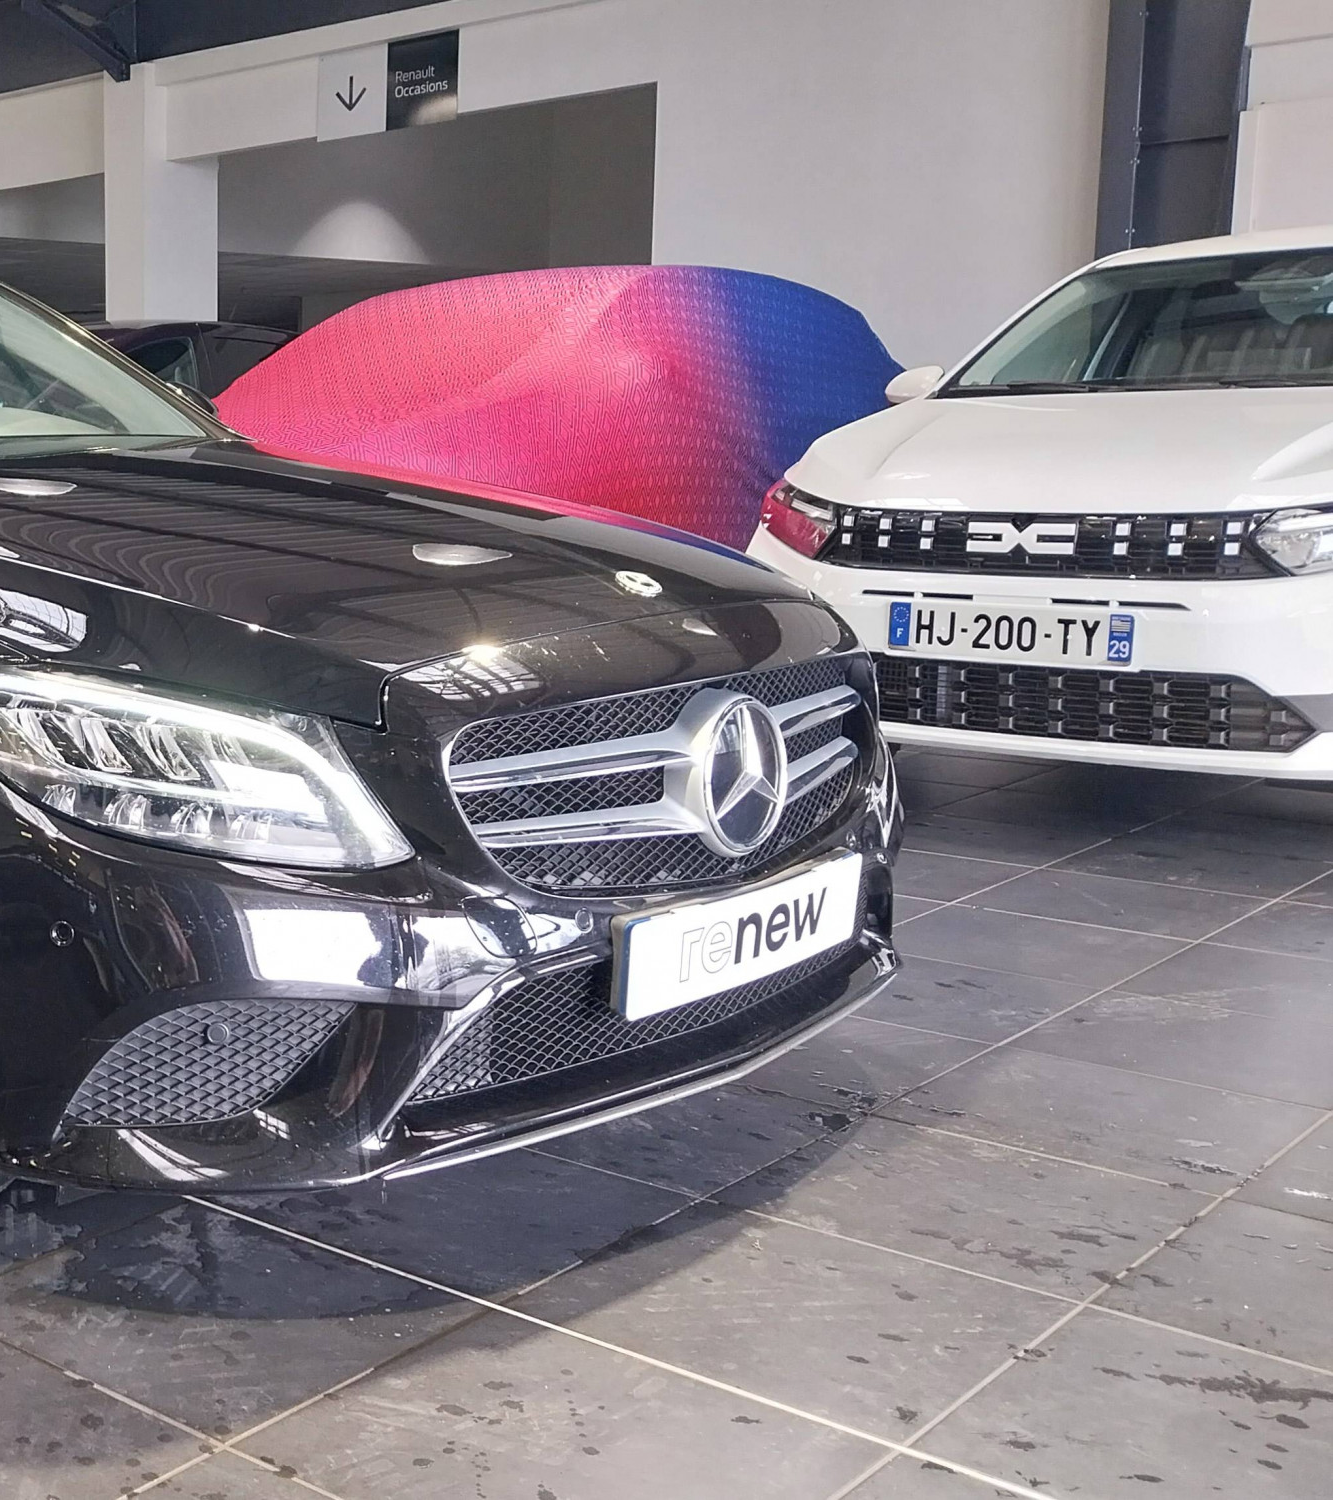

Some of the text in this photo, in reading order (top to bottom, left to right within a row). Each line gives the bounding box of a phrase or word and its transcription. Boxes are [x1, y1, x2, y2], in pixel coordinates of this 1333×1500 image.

[395, 65, 435, 83] Renault
[394, 80, 449, 98] Occasions
[896, 627, 904, 638] F
[915, 609, 1101, 656] HJ-200-TY
[1109, 639, 1130, 658] 29
[679, 886, 828, 983] renew
